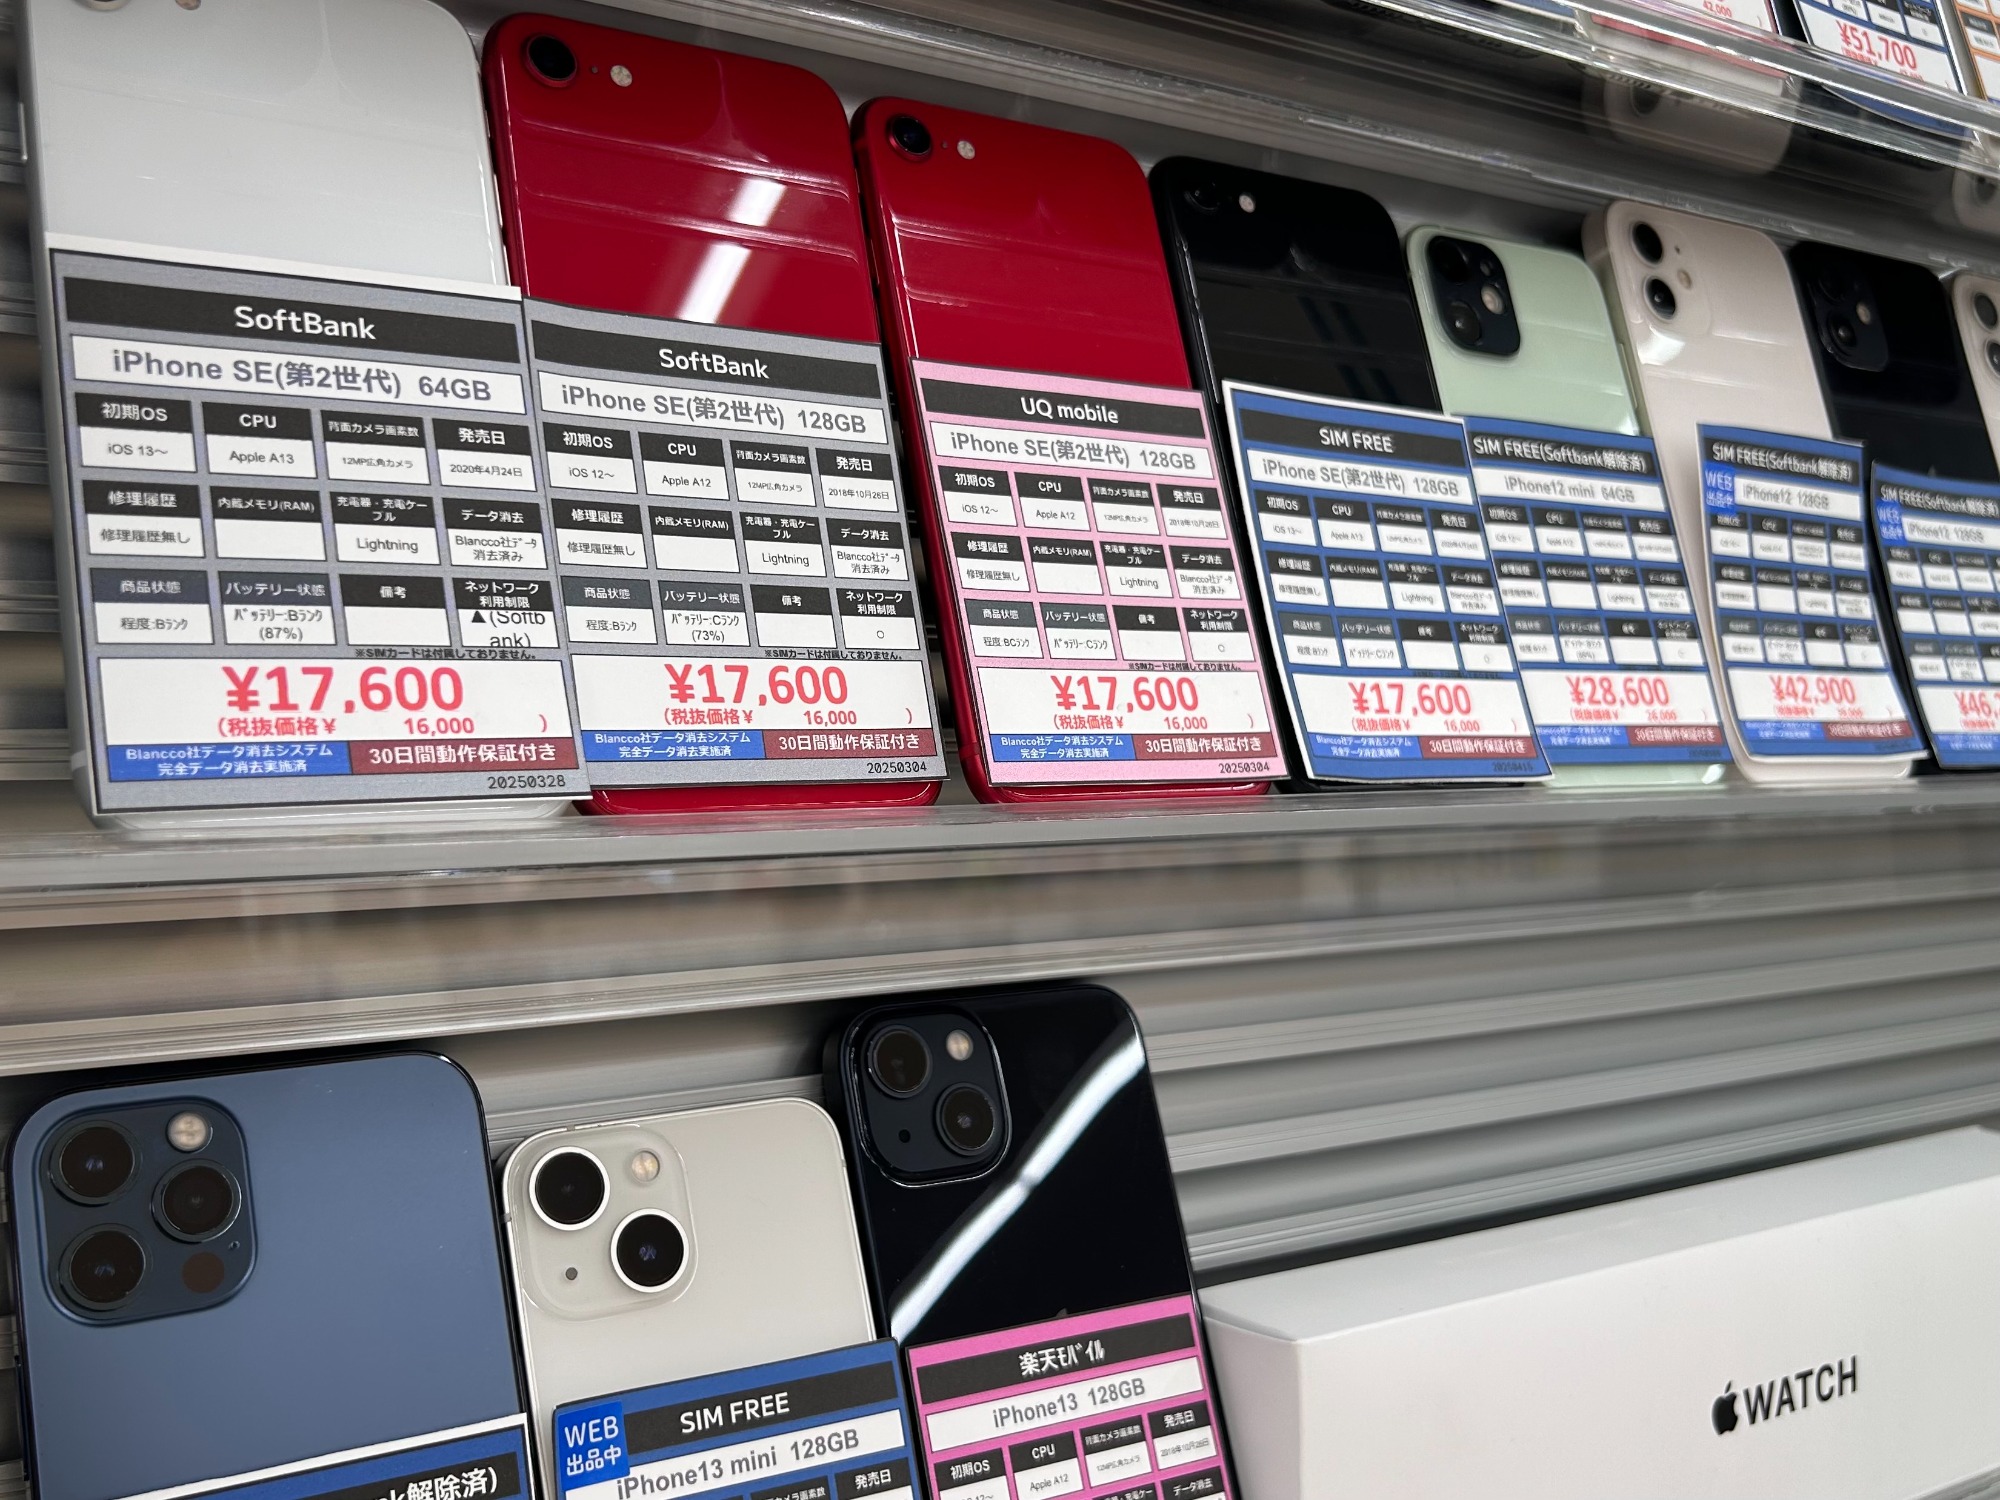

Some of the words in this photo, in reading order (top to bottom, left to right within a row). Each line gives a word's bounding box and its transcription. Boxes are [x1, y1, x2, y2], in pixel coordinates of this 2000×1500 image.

[1835, 19, 1918, 71] ¥51,700
[234, 305, 376, 340] SoftBank
[659, 348, 770, 379] SoftBank
[113, 349, 222, 380] iPhone
[233, 359, 401, 398] SE(第2世代)
[419, 376, 491, 401] 64GB
[102, 402, 168, 422] 初期OS
[562, 383, 646, 412] iPhone
[653, 394, 785, 430] SE(第2世代)
[798, 409, 866, 433] 128GB
[1020, 397, 1053, 419] UQ
[1057, 403, 1119, 424] mobile
[239, 413, 277, 429] CPU
[328, 421, 419, 437] 背面カメラ画素数
[459, 427, 505, 446] 発売日
[563, 430, 614, 449] 初期OS
[1318, 427, 1349, 448] SIM
[1352, 431, 1395, 453] FREE
[108, 443, 133, 455] iOS
[668, 442, 697, 457] CPU
[950, 432, 1018, 455] iPhone
[1024, 439, 1129, 468] SE(第2世代)
[1139, 449, 1196, 470] 128GB
[1472, 436, 1501, 456] SIM
[1712, 441, 1736, 463] SIM
[229, 450, 266, 465] Apple
[269, 453, 295, 465] A13
[836, 456, 873, 472] 発売日
[450, 464, 523, 477] 2020年4月24日
[568, 466, 588, 478] iOS
[1263, 458, 1316, 481] iPhone
[1321, 466, 1405, 494] SE(第2世代)
[1413, 476, 1459, 497] 128GB
[662, 474, 689, 488] Apple
[692, 477, 712, 488] A12
[954, 472, 995, 488] 初期OS
[1038, 481, 1062, 493] CPU
[1504, 474, 1565, 497] iPhone12
[1568, 482, 1595, 499] mini
[1705, 469, 1733, 492] WEB
[108, 491, 178, 508] 修理履歴
[828, 487, 889, 500] 2018年10月26日
[1172, 490, 1204, 504] 発売日
[218, 498, 315, 513] 内蔵メモリ(RAM)
[962, 504, 978, 514] iOS
[1331, 504, 1353, 516] CPU
[461, 509, 524, 524] データ消去
[571, 508, 624, 525] 修理履歴
[655, 515, 729, 531] 内蔵メモリ(RAM)
[1036, 509, 1058, 521] Apple
[1060, 511, 1076, 520] A12
[101, 528, 190, 544] 修理履歴無し
[841, 528, 889, 541] データ消去
[357, 537, 418, 553] Lightning
[567, 541, 635, 556] 修理履歴無し
[967, 540, 1009, 554] 修理履歴
[473, 549, 523, 562] 消去済み
[762, 552, 809, 567] Lightning
[1181, 553, 1223, 565] データ消去
[851, 563, 890, 575] 消去済み
[966, 569, 1020, 581] 修理履歴無し
[120, 580, 181, 594] 商品状態
[225, 581, 326, 597] バッテリー状態
[465, 581, 540, 594] ネットワーク
[1120, 576, 1158, 589] Lightning
[380, 585, 407, 599] 備考
[584, 587, 631, 600] 商品状態
[664, 590, 740, 604] バッテリー状態
[846, 590, 903, 603] ネットワーク
[480, 595, 530, 608] 利用制限
[857, 603, 897, 616] 利用制限
[982, 608, 1019, 620] 商品状態
[1045, 610, 1106, 623] バッテリー状態
[1190, 609, 1238, 620] ネットワーク
[259, 628, 303, 642] (87%)
[691, 630, 725, 643] (73%)
[221, 666, 464, 714] ¥17,600
[664, 663, 848, 706] ¥17,600
[1565, 675, 1671, 708] ¥28,600
[1769, 673, 1856, 705] ¥42,900
[1050, 675, 1199, 713] ¥17,600
[1348, 681, 1472, 717] ¥17,600
[803, 710, 857, 727] 16,000
[1163, 716, 1208, 732] 16,000
[404, 717, 475, 737] 16,000
[595, 731, 751, 744] Blancco社データ消去システム
[778, 733, 919, 751] 30日間動作保証付き
[1145, 737, 1262, 753] 30日間動作保証付き
[126, 743, 333, 760] Blancco社データ消去システム
[369, 743, 556, 764] 30日間動作保証付き
[619, 745, 731, 758] 完全データ消去実施済
[158, 759, 307, 776] 完全データ消去実施済
[867, 761, 927, 774] 20250304
[1218, 762, 1270, 774] 20250304
[487, 774, 566, 790] 20250328
[1742, 1354, 1858, 1426] WATCH
[993, 1391, 1078, 1428] iPhone13
[1088, 1377, 1145, 1407] 128GB
[680, 1406, 724, 1434] SIM
[730, 1391, 790, 1424] FREE
[1163, 1409, 1195, 1427] 発売日
[564, 1414, 619, 1449] WEB
[1031, 1443, 1056, 1459] CPU
[566, 1445, 621, 1476] 出品中
[616, 1457, 724, 1500] iPhone13
[730, 1446, 777, 1474] mini
[790, 1428, 859, 1461] 128GB
[950, 1459, 991, 1479] 初期OS
[855, 1469, 892, 1489] 発売日
[1030, 1478, 1051, 1491] Apple
[1053, 1473, 1069, 1485] A12
